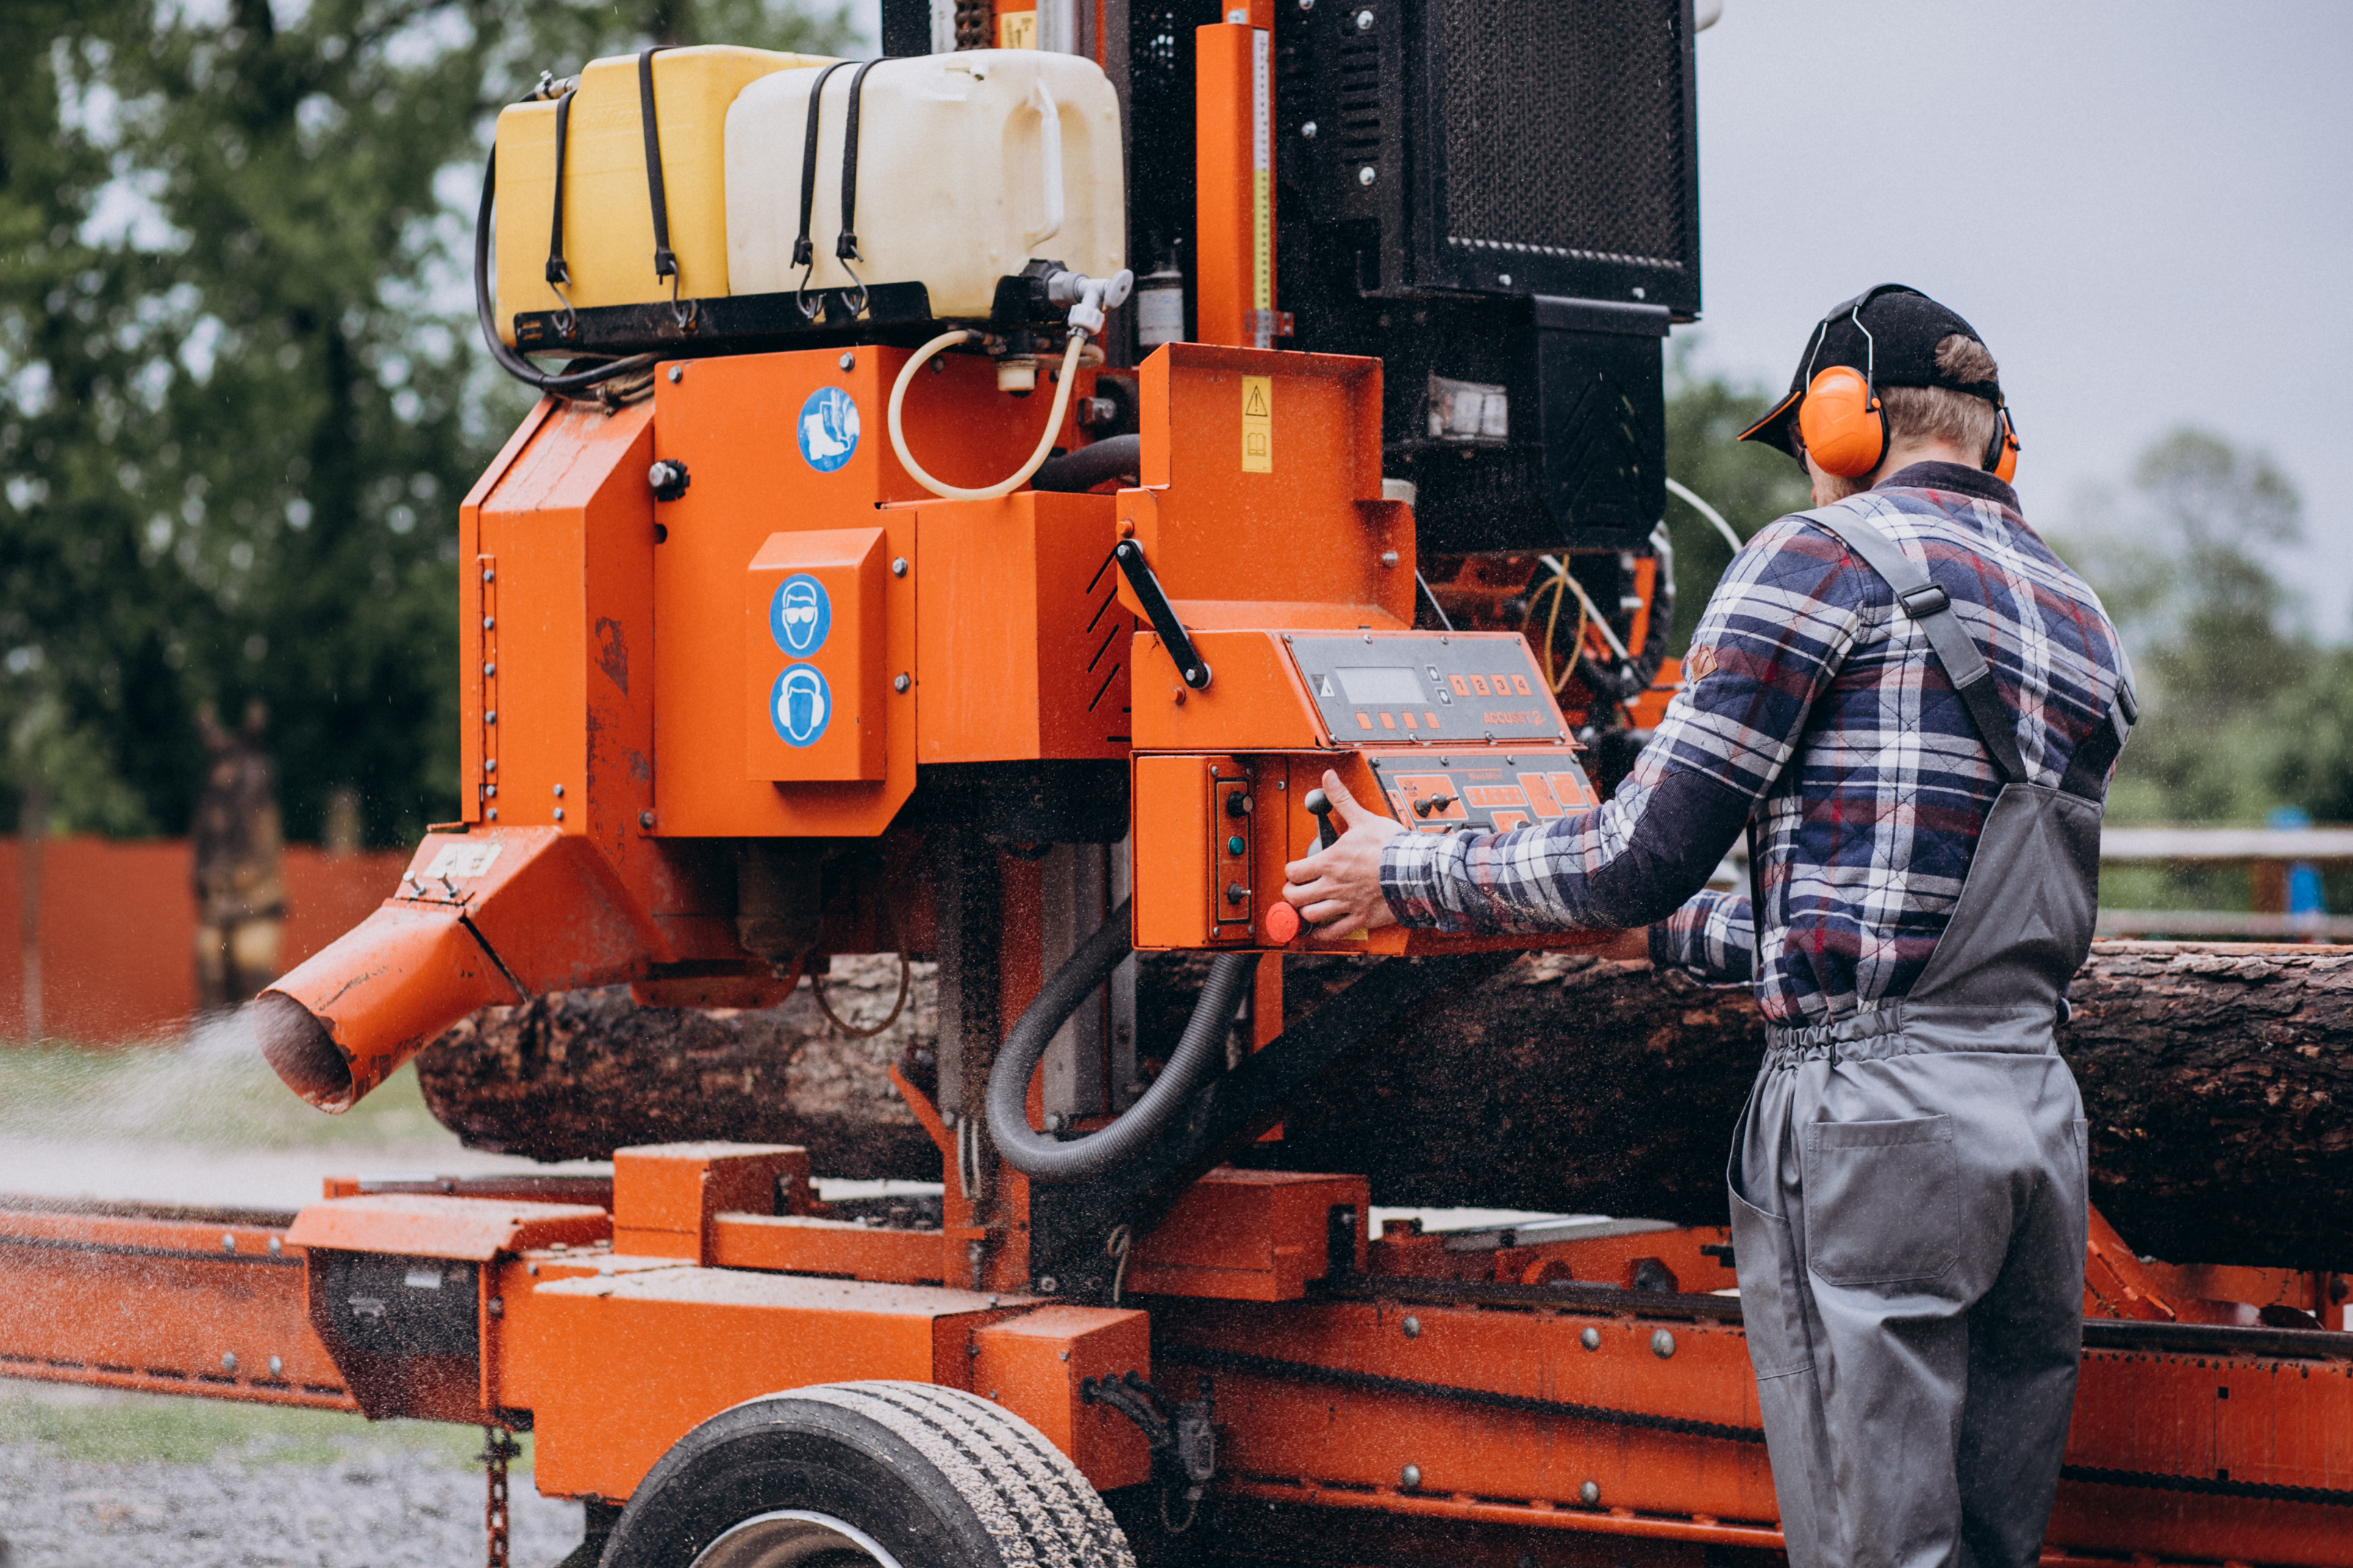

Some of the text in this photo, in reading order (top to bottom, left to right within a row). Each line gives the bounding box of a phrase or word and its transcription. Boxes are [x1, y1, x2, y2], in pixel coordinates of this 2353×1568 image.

[1456, 680, 1526, 690] 1 2 3 4
[1482, 710, 1546, 726] ACCUSET 2
